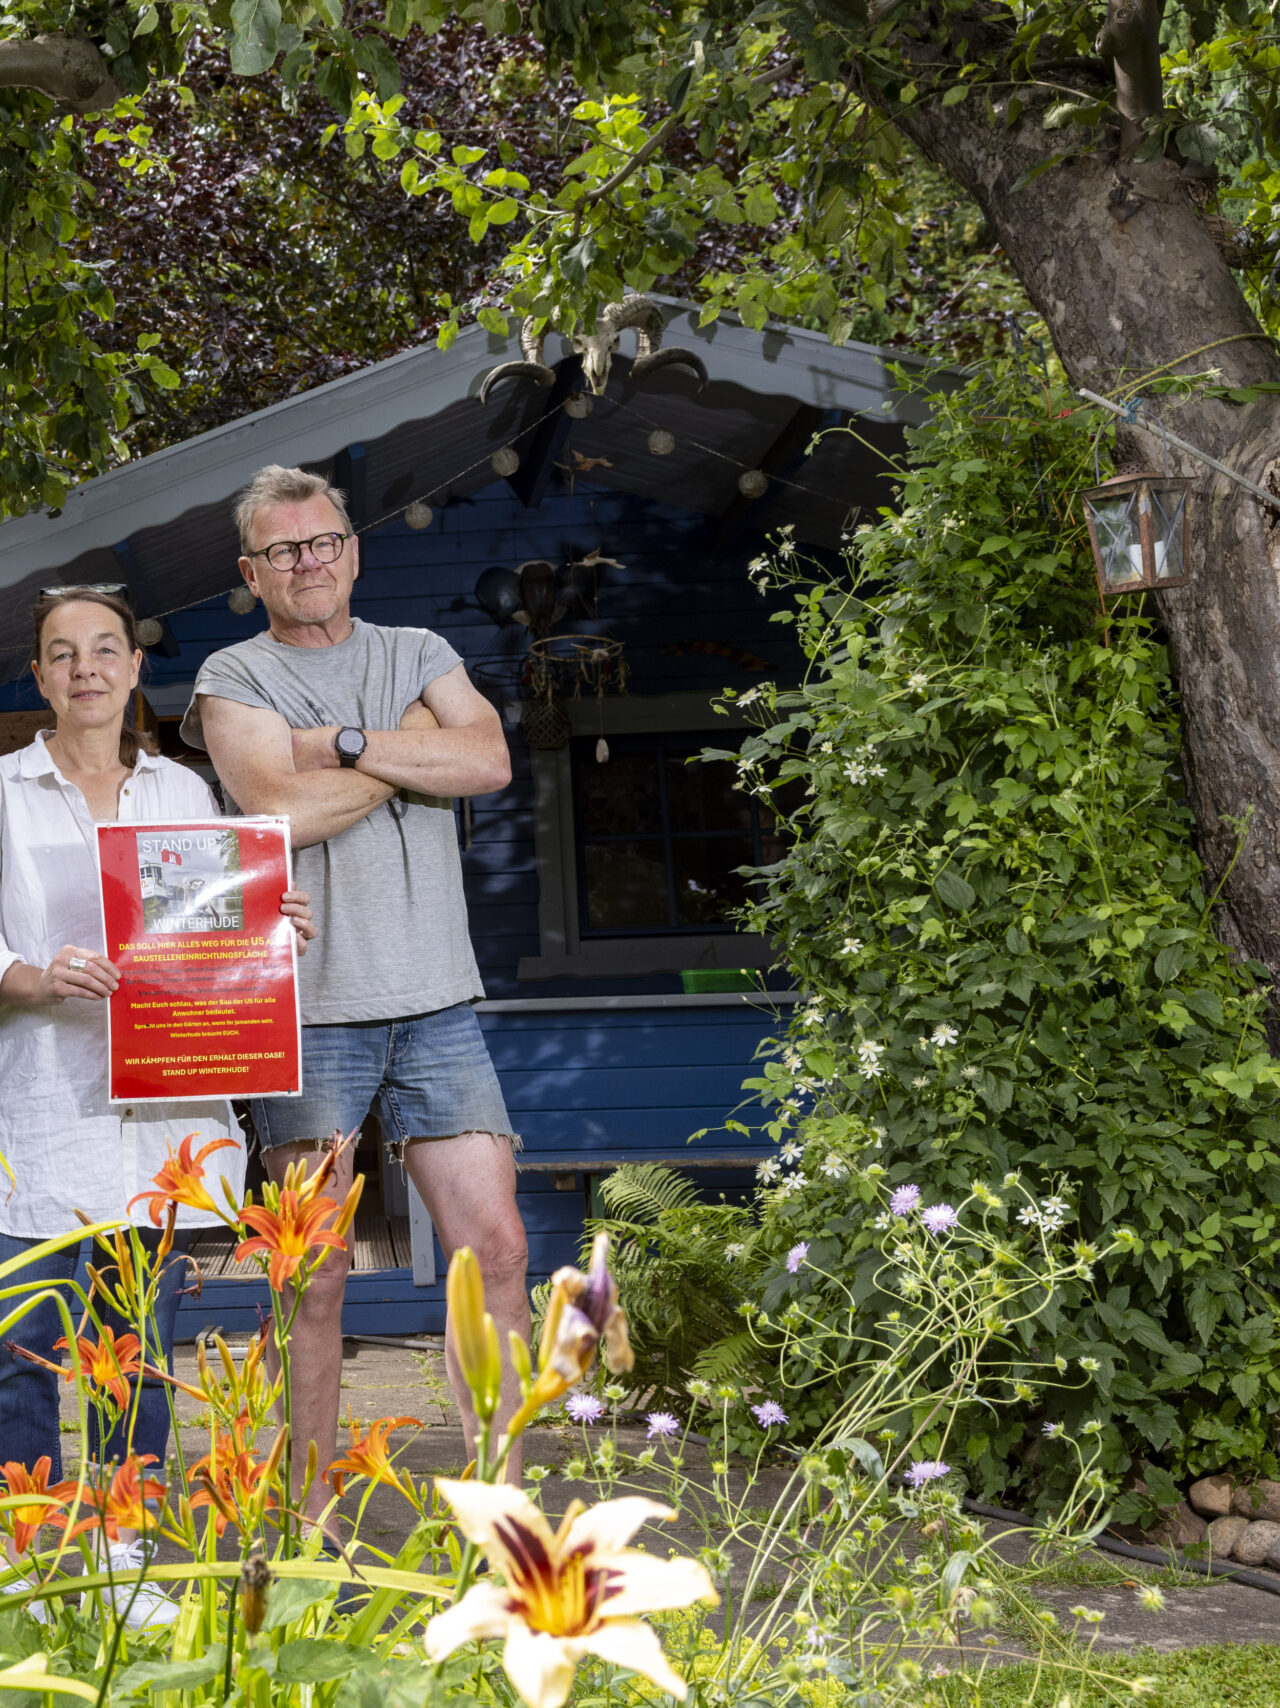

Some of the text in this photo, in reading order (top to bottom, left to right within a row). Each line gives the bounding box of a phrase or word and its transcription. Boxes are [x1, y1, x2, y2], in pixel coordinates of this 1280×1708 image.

[142, 838, 217, 853] STAND UP
[153, 916, 240, 930] WINTERHUDE
[119, 943, 136, 951] DAS
[137, 942, 156, 950] SOLL
[158, 941, 176, 950] HIER
[177, 941, 200, 949] ALLES
[201, 940, 219, 948] WEG
[220, 938, 235, 947] FÜR
[236, 938, 250, 947] DIE
[251, 936, 264, 946] U5
[133, 950, 269, 963] BAUSTELLENEINRICHTUNGSFLÄCHE
[130, 1001, 151, 1009] Macht
[152, 1001, 168, 1009] Euch
[170, 1000, 194, 1009] schlau,
[254, 997, 264, 1005] für
[172, 1008, 237, 1017] Anwohner bedeutet.
[234, 1018, 261, 1026] jemanden
[141, 1055, 176, 1064] KÄMPFEN
[177, 1054, 192, 1063] FÜR
[193, 1055, 208, 1063] DEN
[209, 1054, 236, 1062] ERHALT
[237, 1052, 263, 1060] DIESER
[264, 1051, 286, 1060] OASE!
[162, 1068, 186, 1077] STAND
[199, 1066, 249, 1075] WINTERHUDE!
